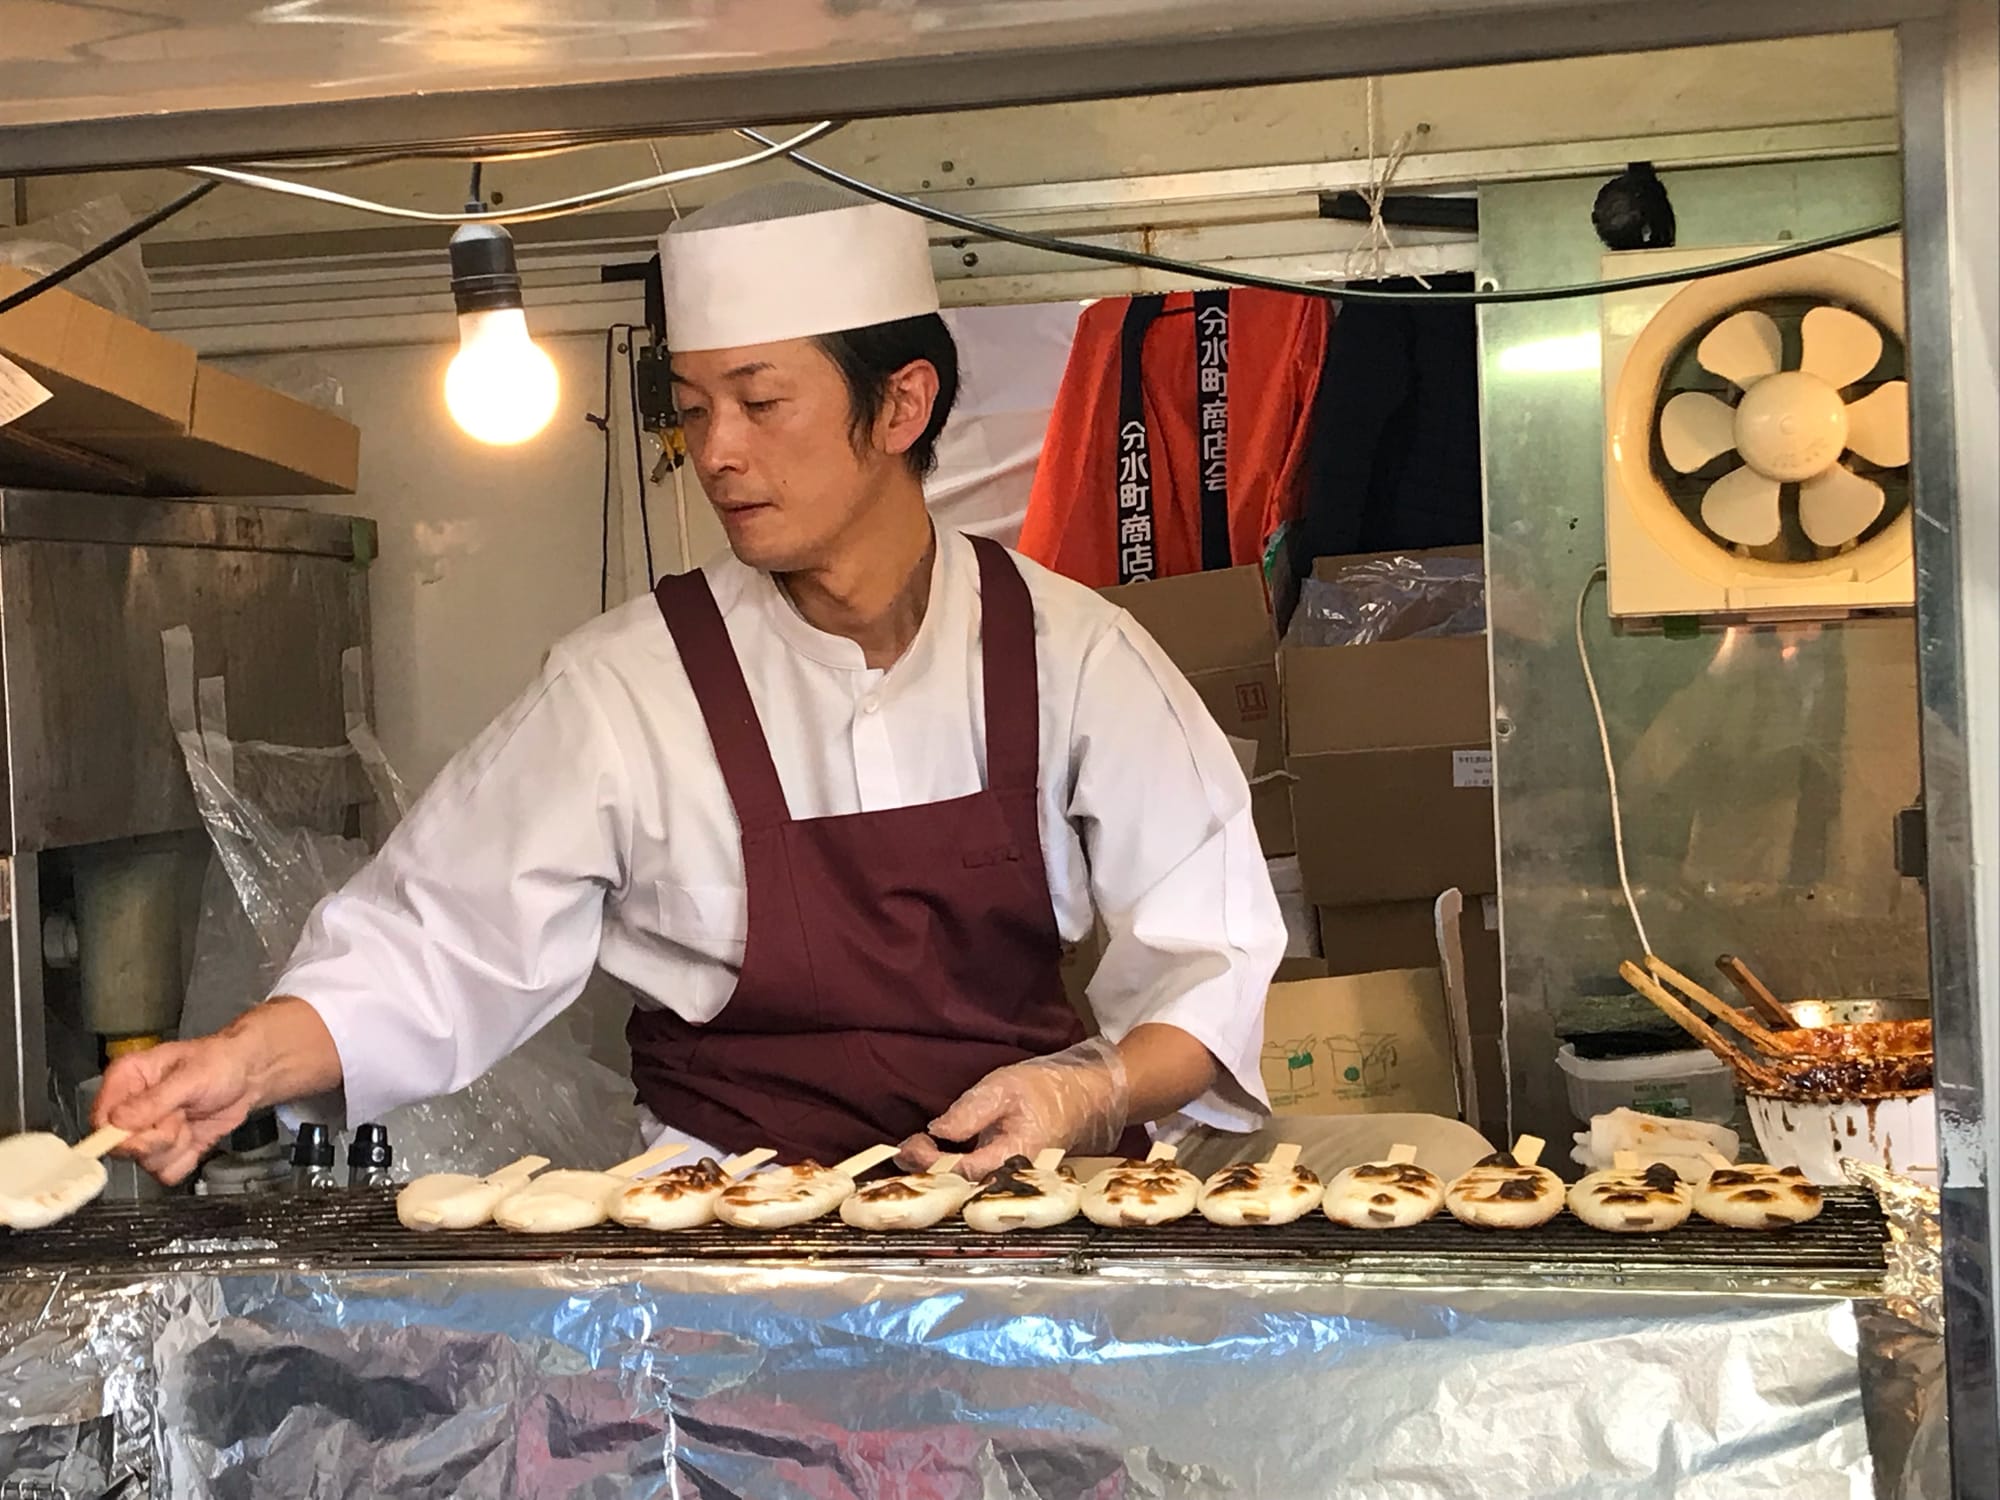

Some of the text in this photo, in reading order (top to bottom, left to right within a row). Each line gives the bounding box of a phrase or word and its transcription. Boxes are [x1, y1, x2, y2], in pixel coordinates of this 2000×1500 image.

[1198, 306, 1228, 491] 分水町商店会
